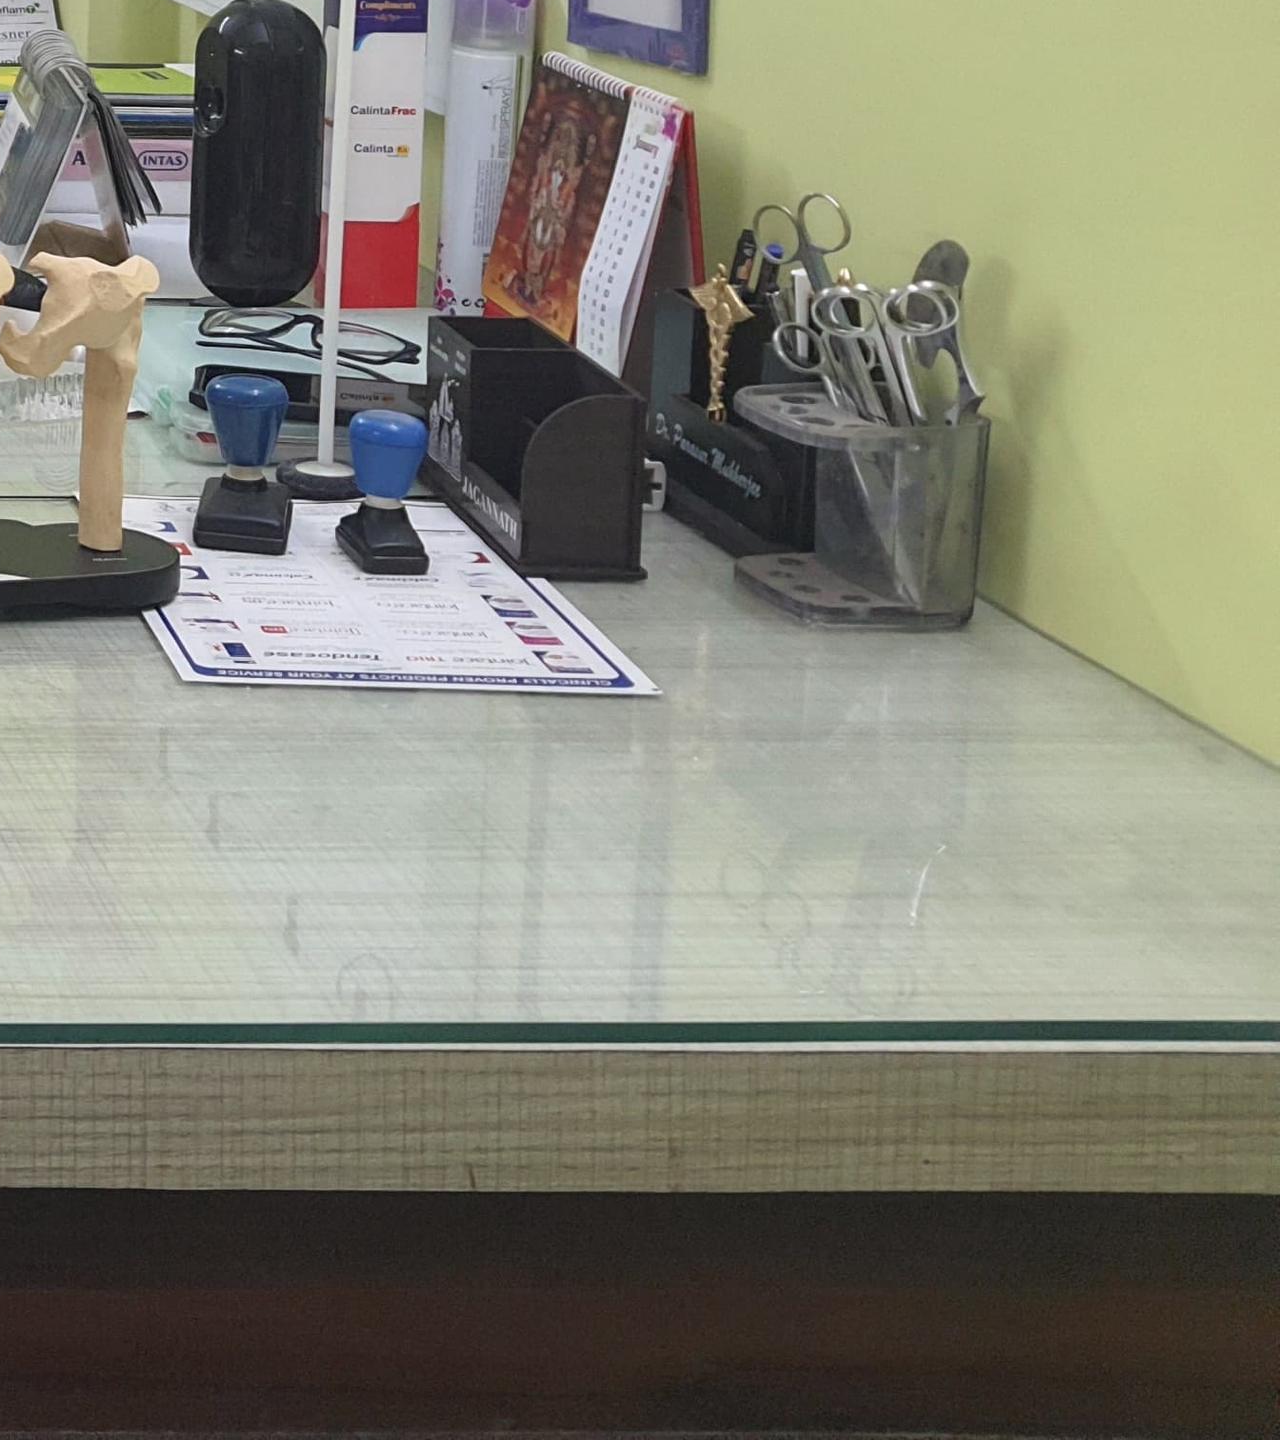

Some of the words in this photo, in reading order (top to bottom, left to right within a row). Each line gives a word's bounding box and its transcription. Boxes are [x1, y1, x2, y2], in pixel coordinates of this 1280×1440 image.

[353, 143, 394, 154] Calinta
[142, 155, 183, 166] INTAS
[462, 475, 518, 541] JAGANNATH
[217, 669, 284, 679] SERVICE
[287, 671, 334, 679] YOUR
[335, 672, 355, 680] AT
[360, 673, 448, 682] PRODUCTS
[451, 675, 517, 684] PROVEN
[523, 678, 612, 687] CLINICALLY
